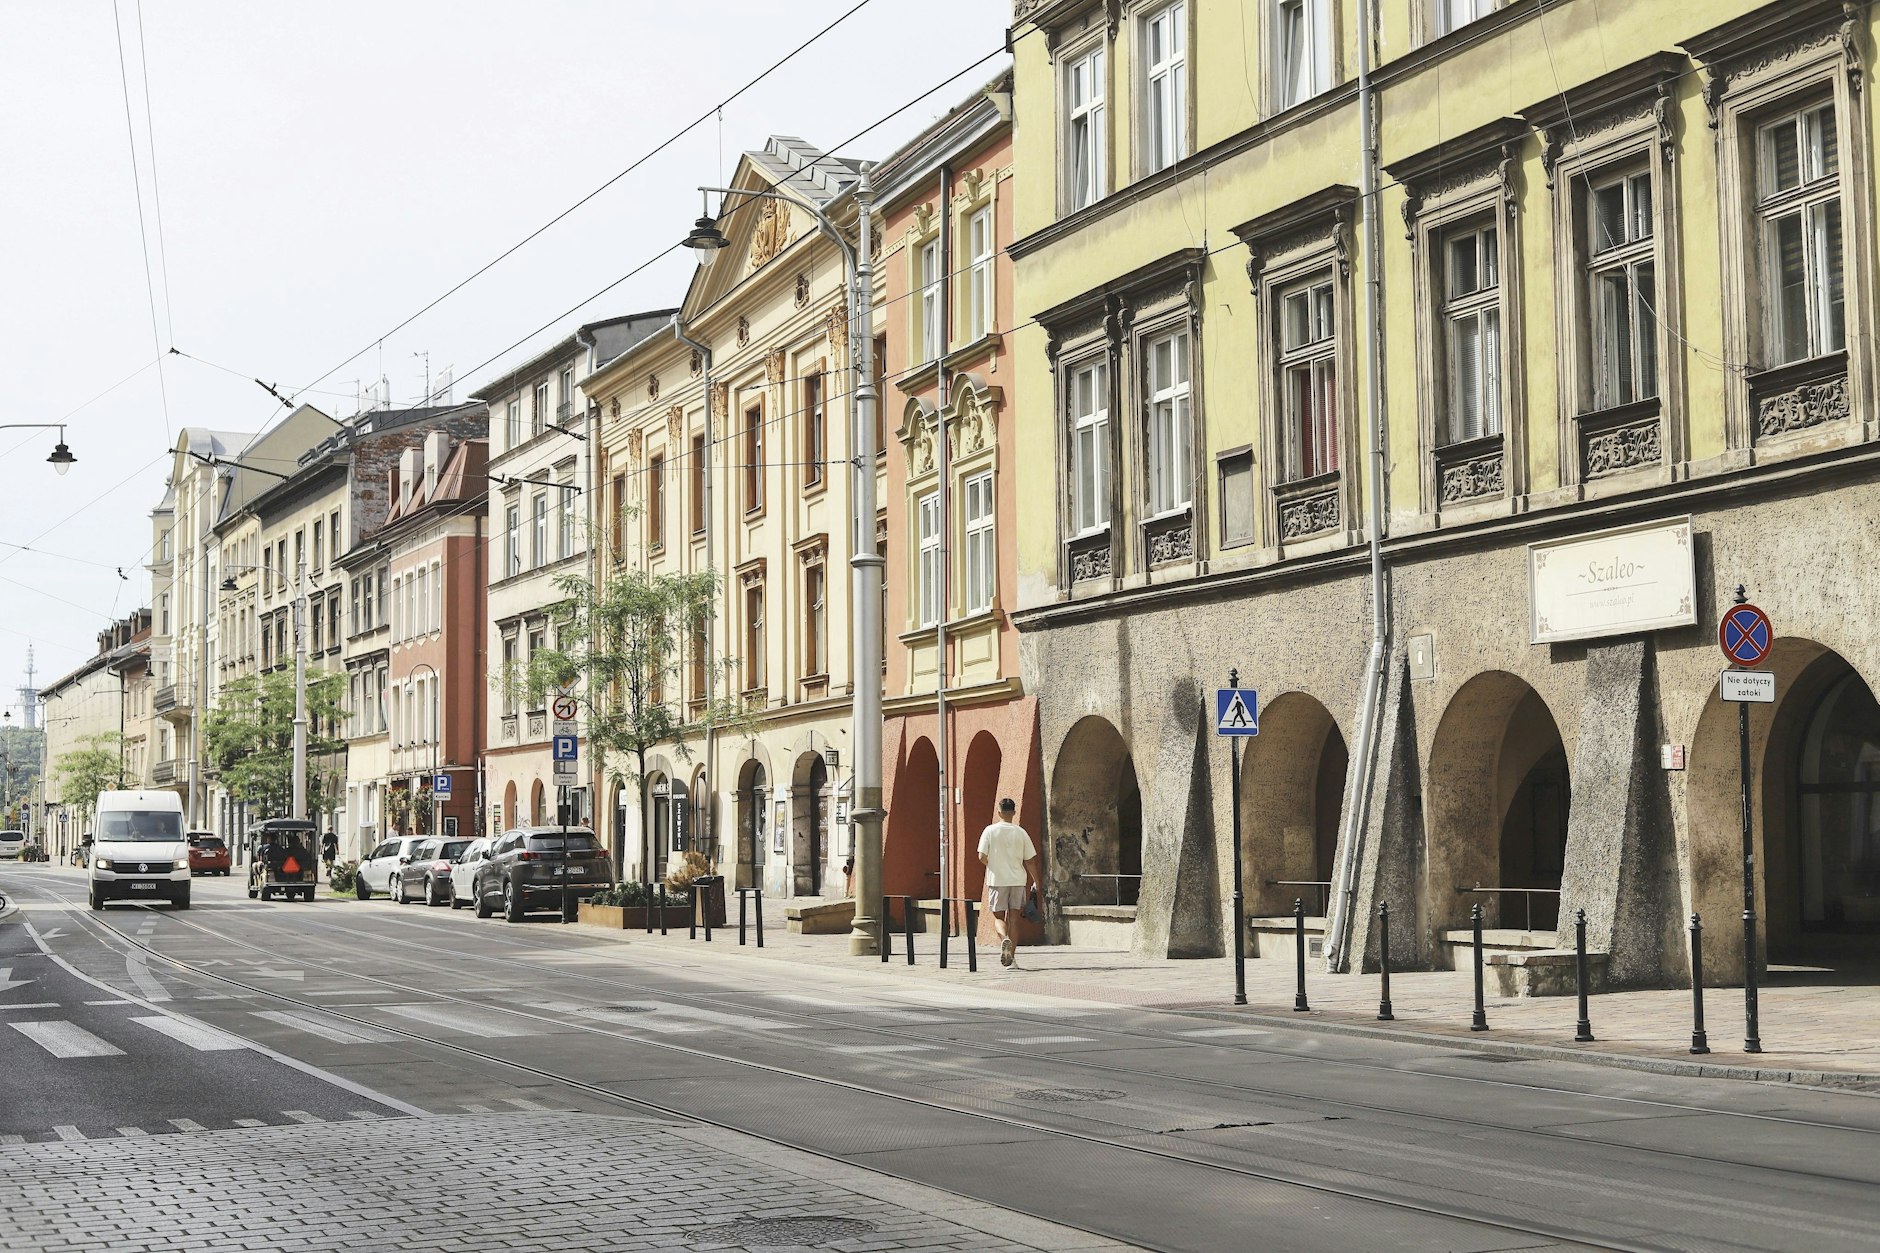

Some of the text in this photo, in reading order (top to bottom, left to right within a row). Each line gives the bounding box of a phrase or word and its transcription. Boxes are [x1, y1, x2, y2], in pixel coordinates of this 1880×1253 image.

[1727, 676, 1771, 686] Nie dotyczy
[1737, 689, 1761, 697] zatoki
[558, 738, 573, 758] P
[437, 776, 448, 791] P
